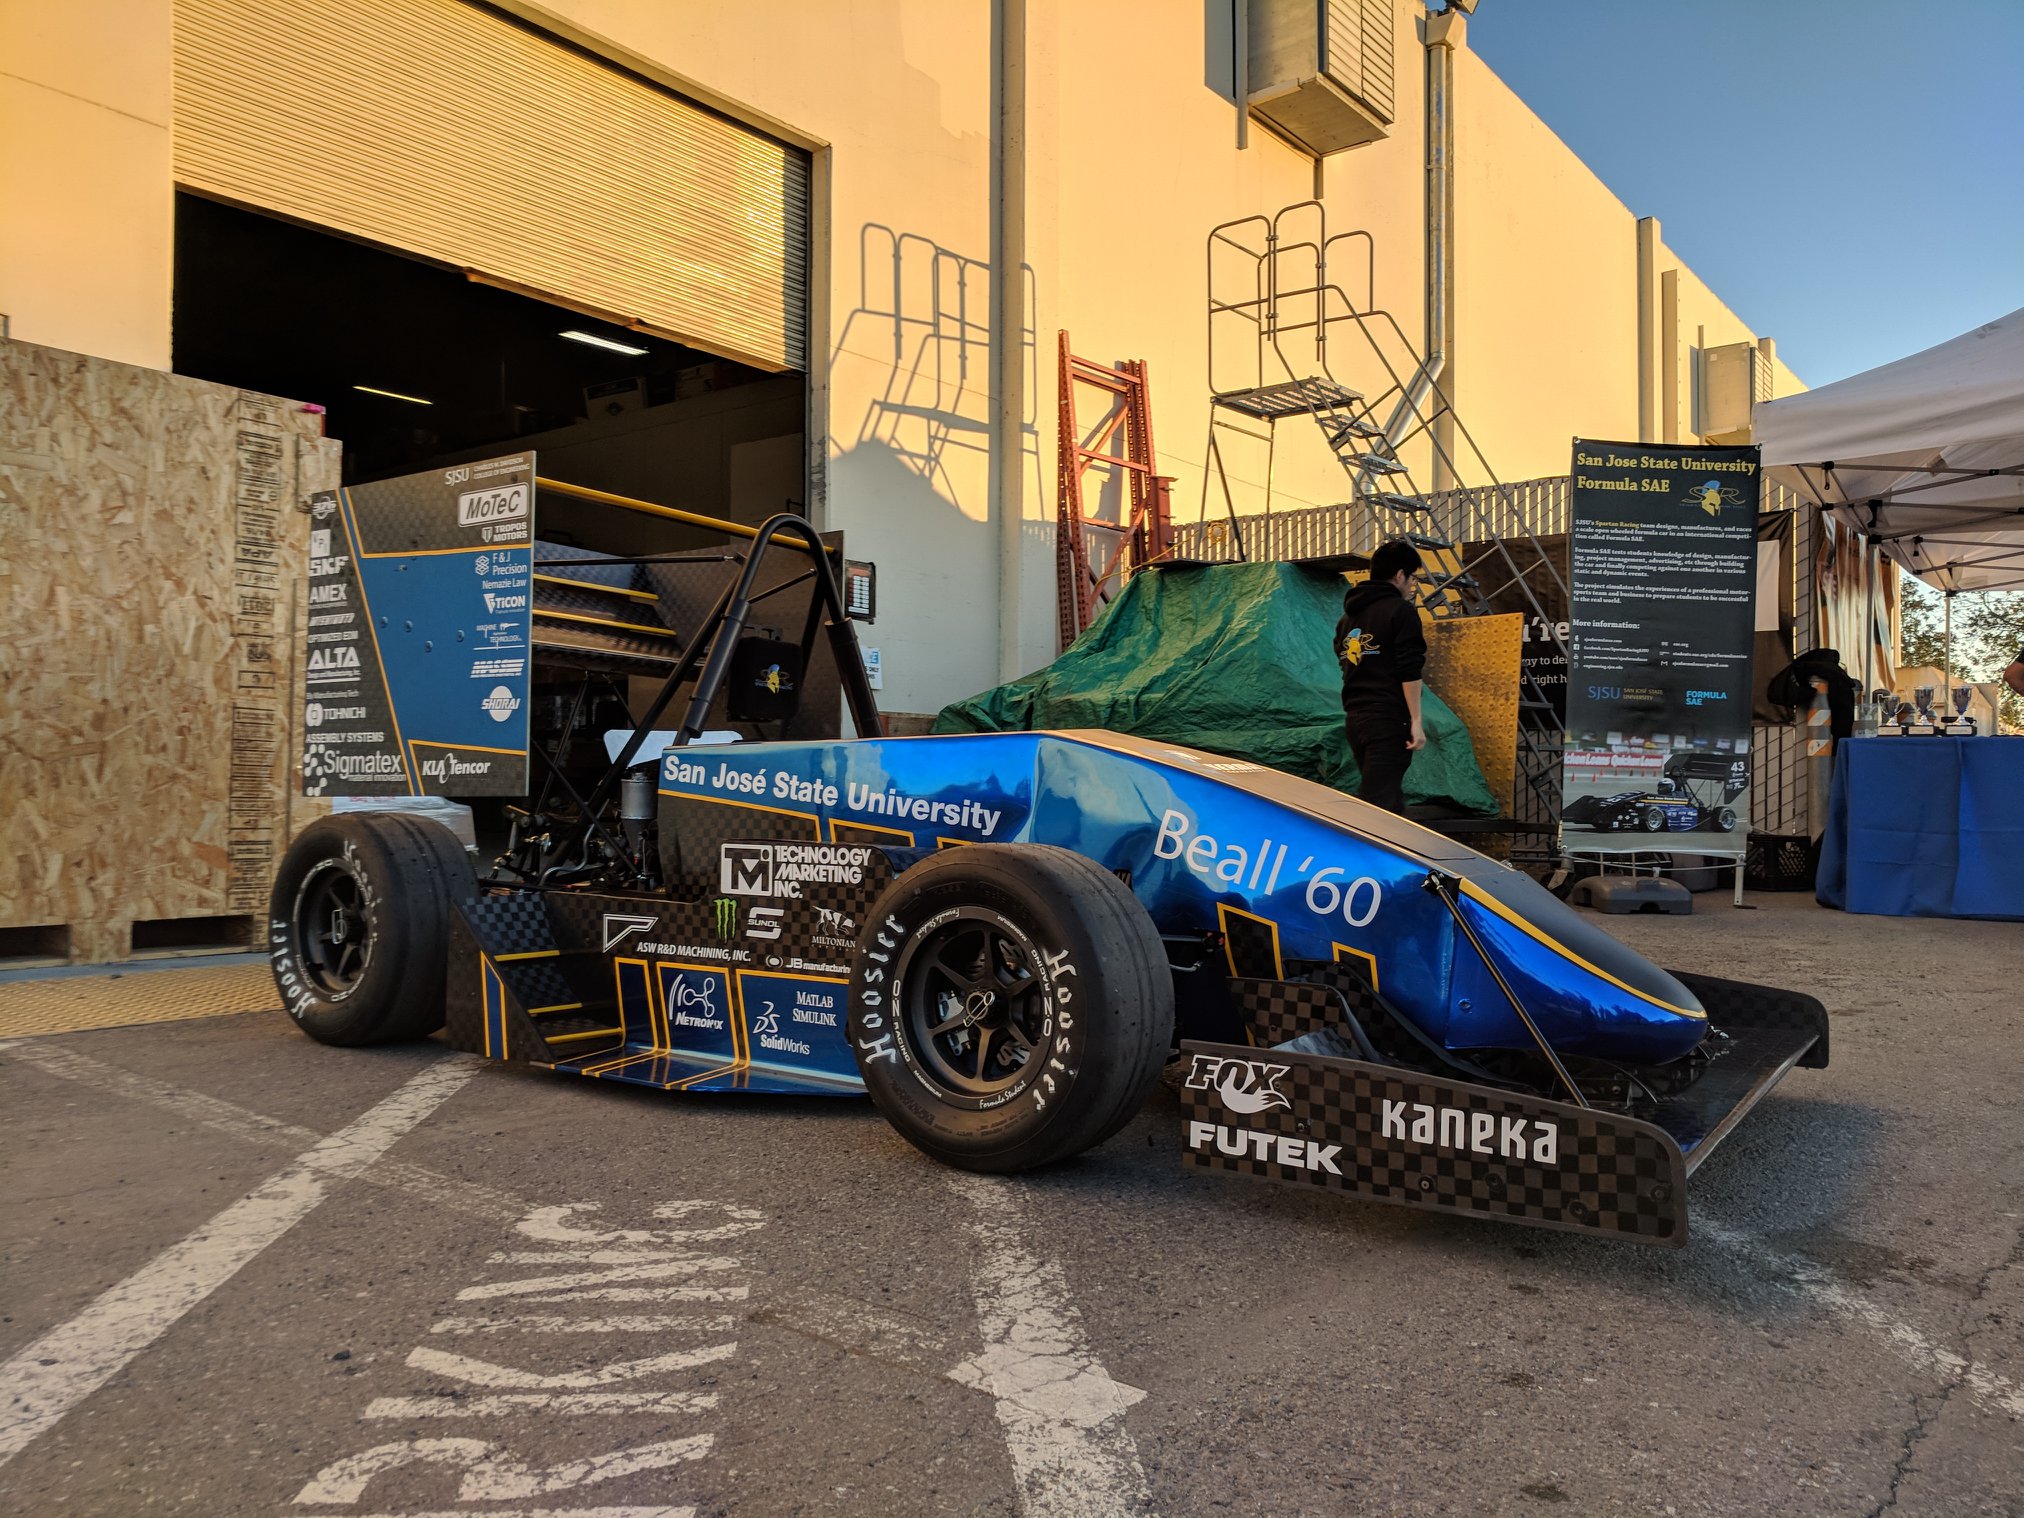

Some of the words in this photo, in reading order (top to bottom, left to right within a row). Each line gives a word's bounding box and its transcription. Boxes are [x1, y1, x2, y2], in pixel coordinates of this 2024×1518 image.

[1577, 453, 1602, 465] San
[1606, 454, 1637, 467] Jose
[1640, 456, 1678, 469] State
[1681, 458, 1756, 475] University
[444, 468, 470, 486] SJSU
[1577, 476, 1638, 491] Formula
[1641, 478, 1670, 492] SAE
[466, 490, 520, 519] MoTeC
[493, 530, 528, 542] MOTORS
[494, 522, 527, 533] TROPOS
[308, 556, 349, 577] SKF
[492, 554, 498, 563] F
[499, 554, 506, 562] &
[506, 552, 511, 562] J
[492, 563, 528, 576] Precision
[482, 579, 511, 590] Nemazie
[512, 578, 526, 588] Law
[1592, 620, 1640, 629] information:
[308, 646, 361, 670] ALTA
[1540, 657, 1550, 665] to
[1588, 686, 1620, 700] SJSU
[1686, 690, 1727, 699] FORMULA
[481, 698, 520, 710] SHORAI
[305, 732, 346, 743] ASSEMBLY
[347, 732, 384, 742] SYSTEMS
[324, 750, 402, 779] Sigmatex
[450, 760, 491, 774] Tencor
[1730, 761, 1745, 772] 43
[664, 754, 706, 785] San
[712, 762, 767, 795] José
[773, 772, 839, 807] State
[847, 783, 1001, 836] University
[775, 845, 871, 867] TECHNOLOGY
[1154, 809, 1288, 896] Beall
[774, 864, 862, 884] MARKETING
[774, 879, 803, 898] INC.
[812, 936, 856, 948] MILTONIAN
[637, 942, 656, 953] ASW
[657, 943, 676, 955] R&D
[677, 945, 732, 961] MACHINING,
[732, 949, 752, 962] INC.
[1031, 950, 1050, 991] RACING
[858, 914, 906, 1065] Hoosier
[796, 991, 834, 1008] MATLAB
[792, 1008, 837, 1026] SIMULINK
[1034, 948, 1078, 1111] Hoosier
[760, 1034, 810, 1055] SolidWorks
[893, 1021, 910, 1062] RACING
[1185, 1054, 1291, 1096] FOX
[980, 1095, 1004, 1109] Formula
[1004, 1080, 1026, 1100] Student
[1190, 1120, 1343, 1176] FUTEK
